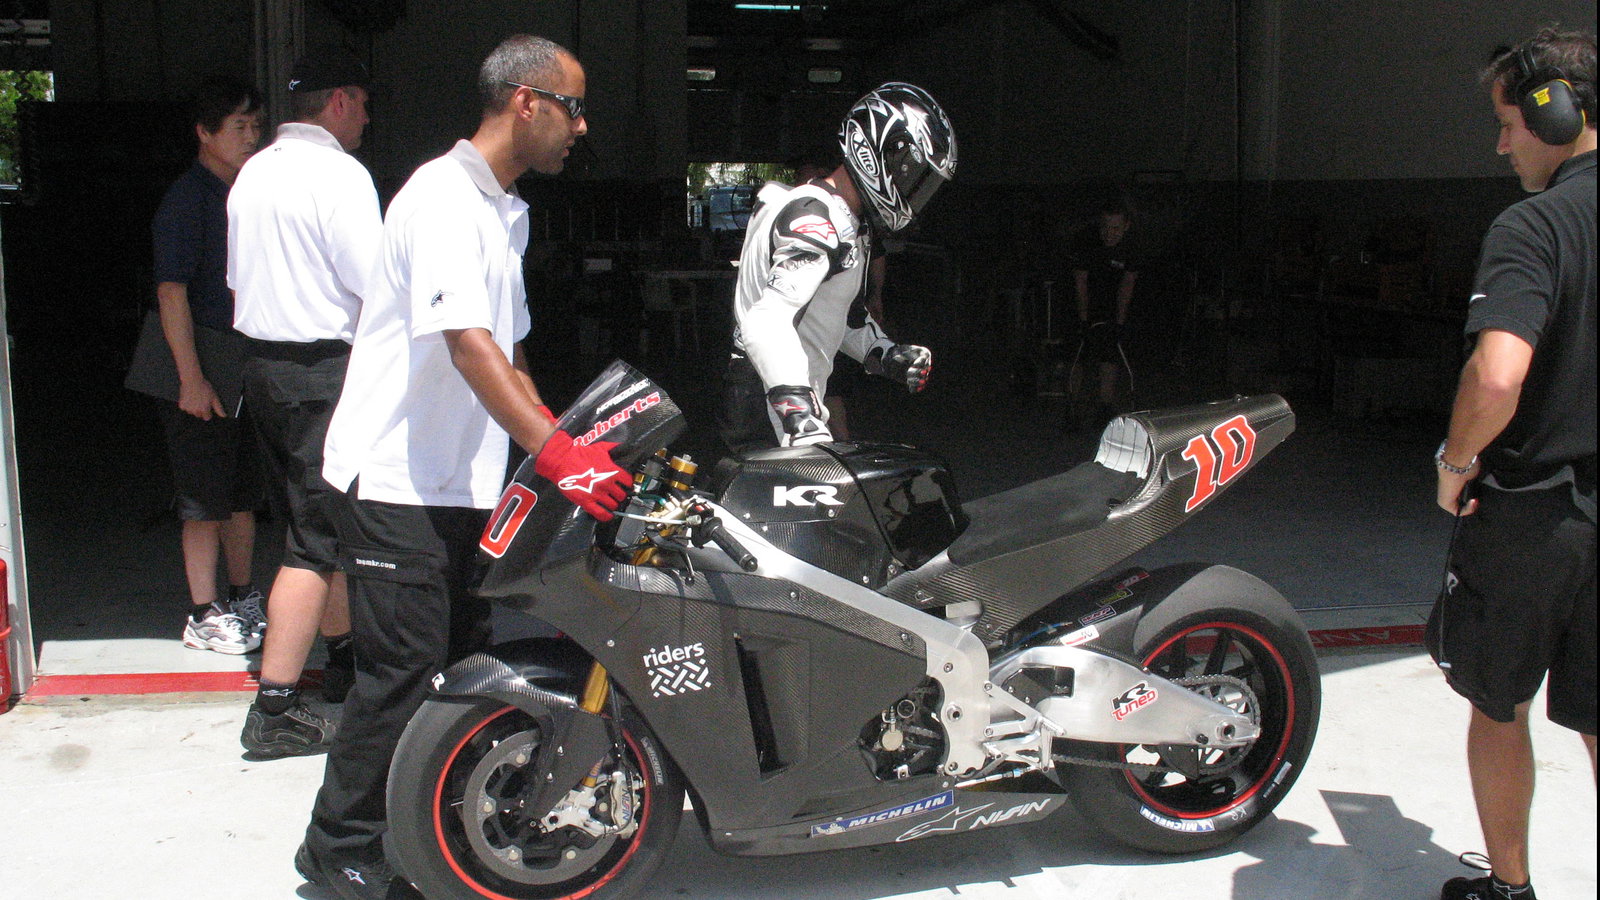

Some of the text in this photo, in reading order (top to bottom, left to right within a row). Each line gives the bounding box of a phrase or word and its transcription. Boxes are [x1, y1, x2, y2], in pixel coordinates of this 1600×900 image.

[1181, 415, 1256, 512] 10
[773, 485, 845, 507] KR
[643, 642, 705, 667] riders
[1112, 682, 1152, 710] KR
[849, 795, 947, 828] MICHELIN
[1142, 807, 1199, 832] MICHELIN
